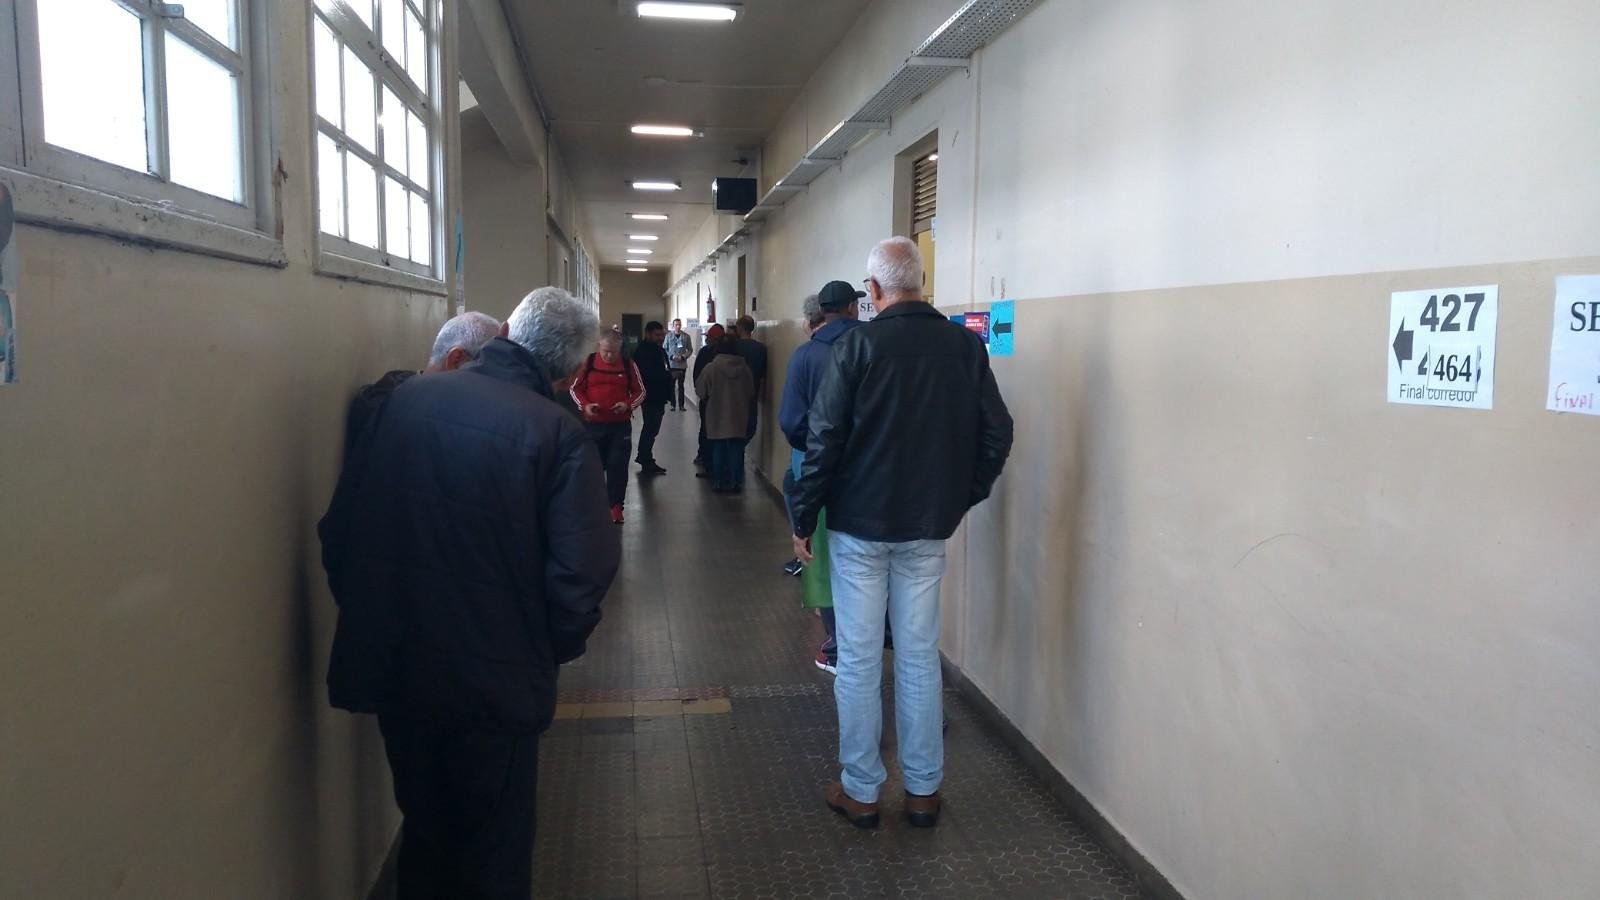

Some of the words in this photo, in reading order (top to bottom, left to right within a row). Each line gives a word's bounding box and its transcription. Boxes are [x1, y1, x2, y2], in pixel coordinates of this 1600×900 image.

[1419, 293, 1486, 332] 427
[1433, 354, 1472, 382] 464
[1399, 383, 1425, 400] Final
